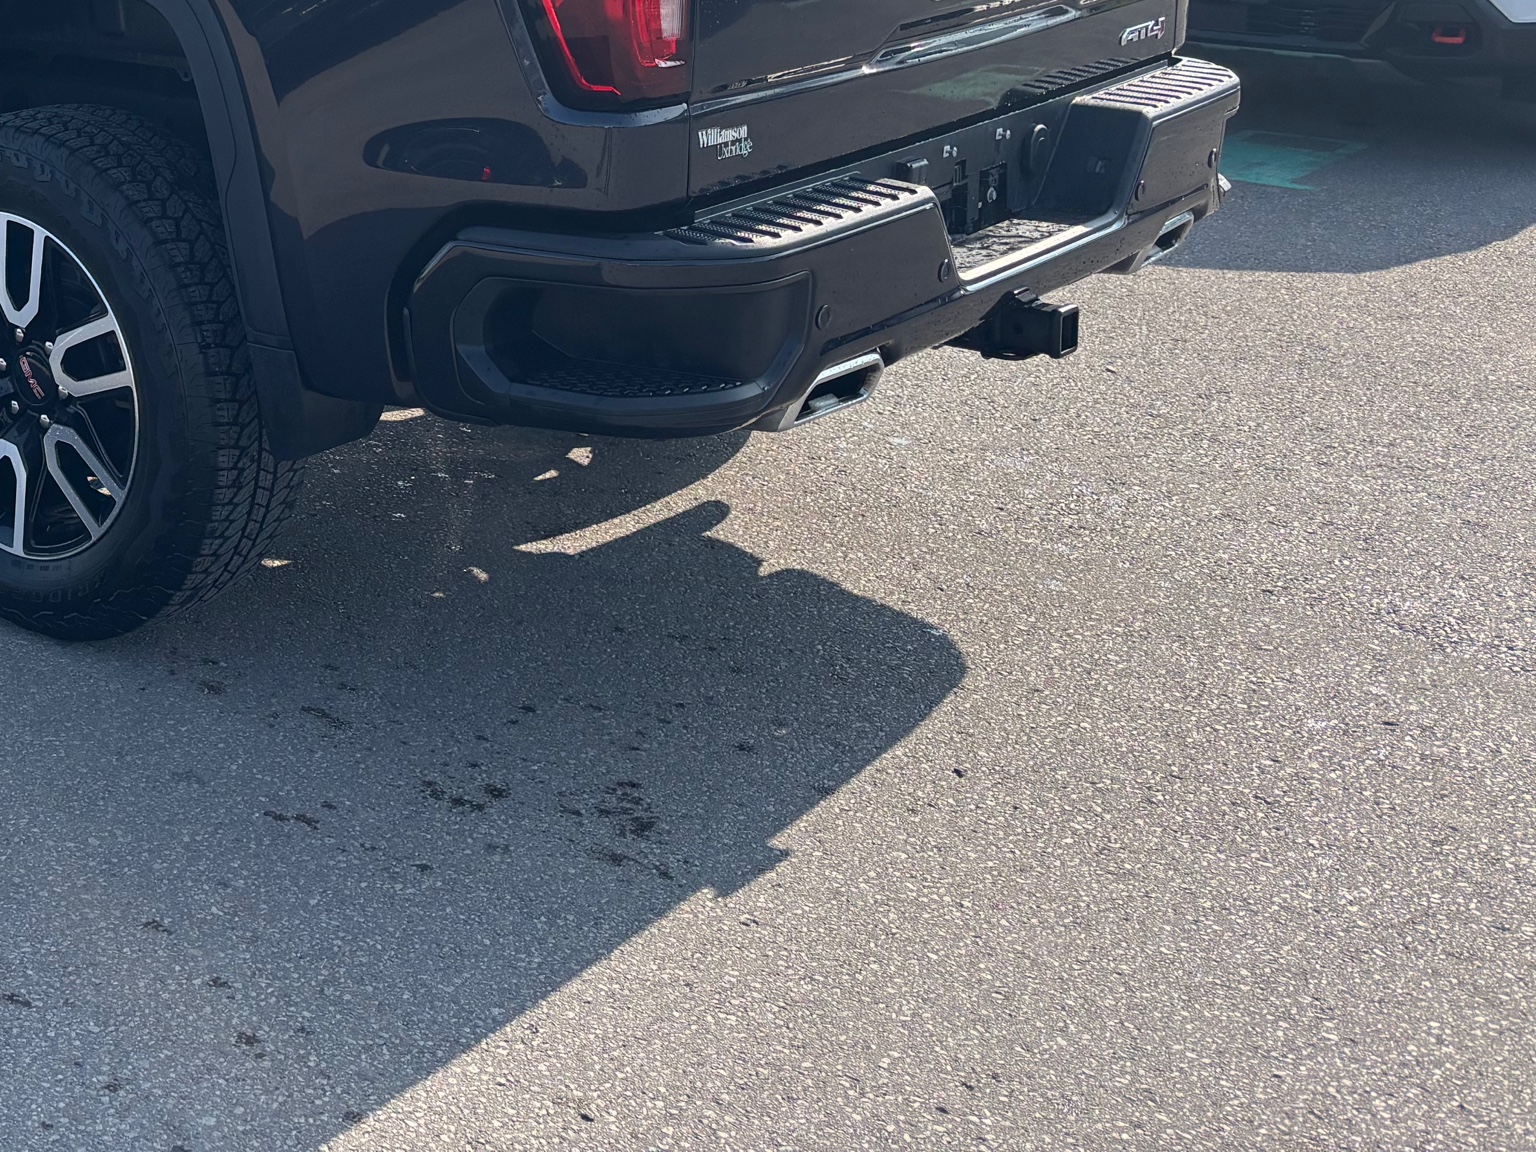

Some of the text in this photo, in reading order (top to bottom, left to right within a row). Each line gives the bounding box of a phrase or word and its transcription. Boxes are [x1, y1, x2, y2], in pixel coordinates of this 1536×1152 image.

[1120, 16, 1166, 47] AT4
[698, 124, 748, 149] Williamson
[716, 137, 754, 160] Uxbridge
[19, 356, 45, 400] GMC
